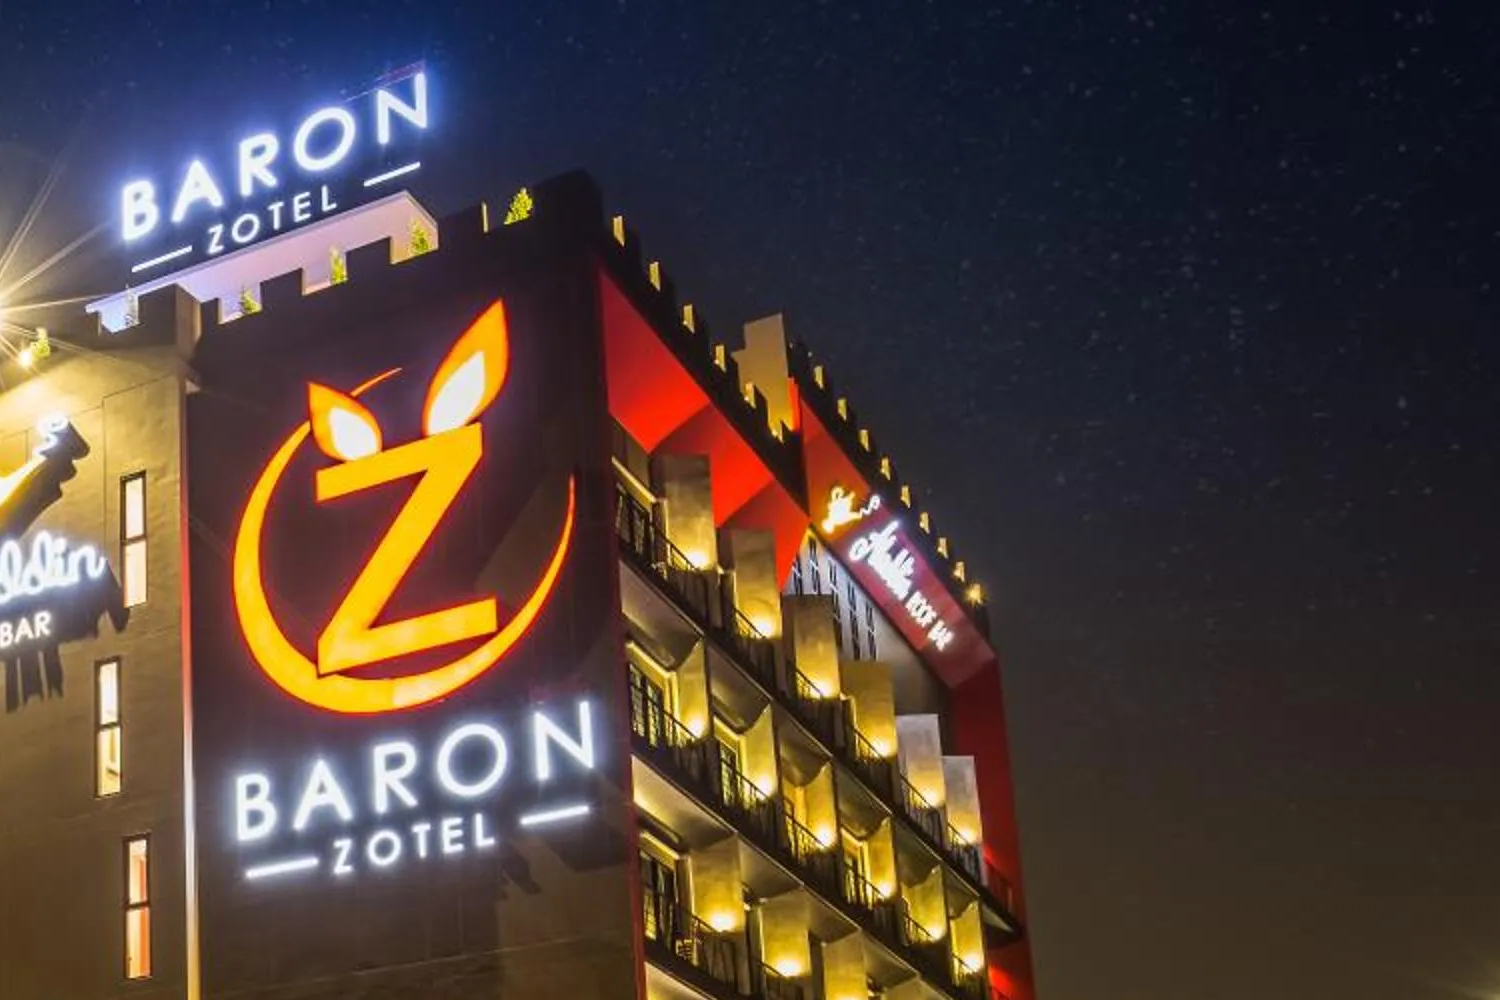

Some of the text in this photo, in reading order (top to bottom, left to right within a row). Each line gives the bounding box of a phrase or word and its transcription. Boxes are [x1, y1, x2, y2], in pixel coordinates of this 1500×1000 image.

[121, 71, 429, 241] BARON
[206, 185, 338, 255] ZOTEL
[234, 700, 595, 841] BARON
[333, 812, 496, 875] ZOTEL
